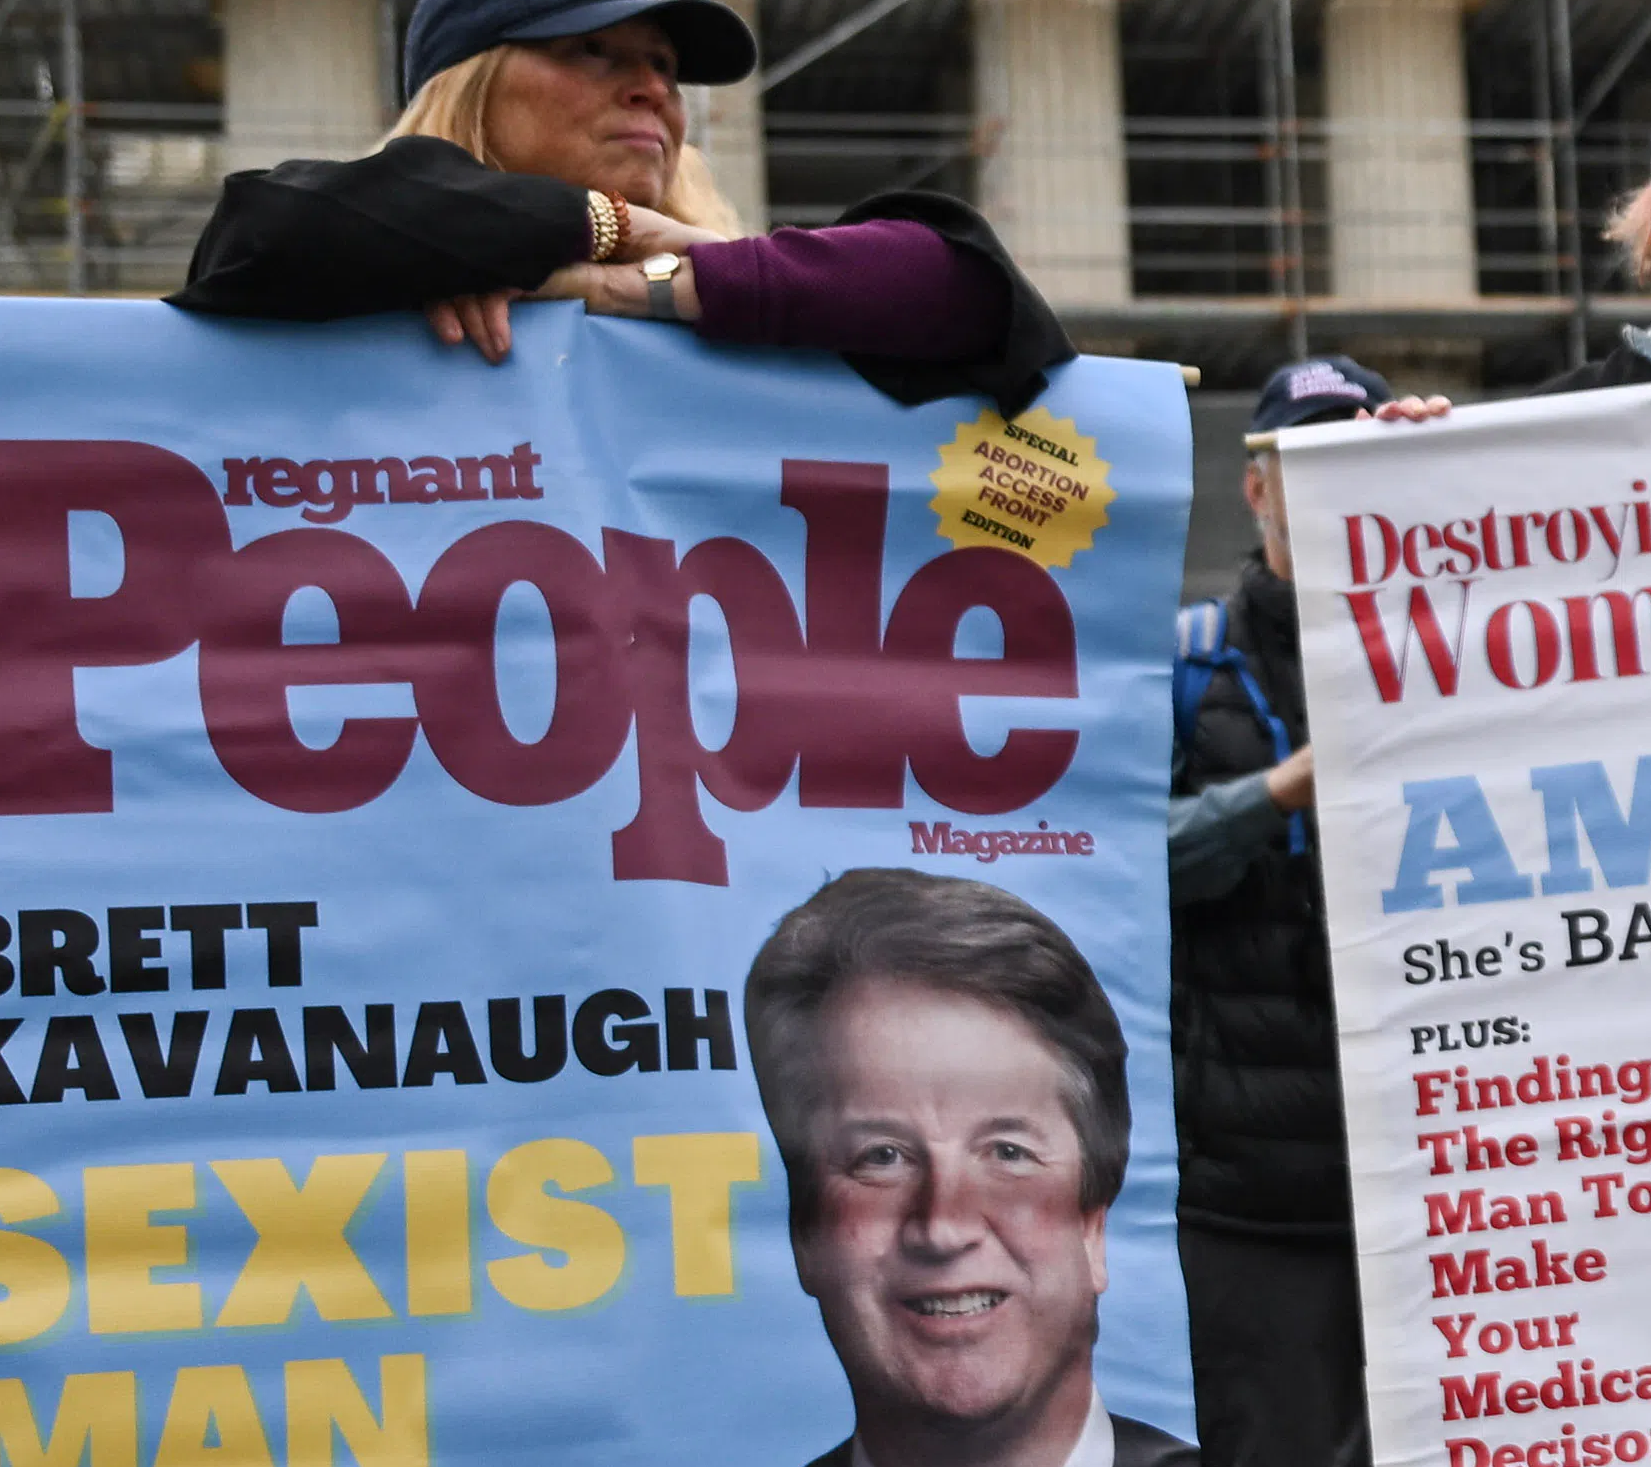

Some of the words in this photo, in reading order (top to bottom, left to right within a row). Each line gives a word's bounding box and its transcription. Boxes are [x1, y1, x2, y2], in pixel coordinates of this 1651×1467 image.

[1004, 423, 1079, 467] SPECIAL
[974, 441, 1090, 501] ABORTION
[979, 466, 1068, 513] ACCESS
[962, 509, 1037, 550] EDITION
[979, 486, 1052, 527] FRONT
[909, 819, 1095, 863] Magazine
[1402, 932, 1545, 986] She's
[1410, 1015, 1530, 1055] PLUS:
[1417, 1125, 1540, 1176] The
[1423, 1185, 1567, 1237] Man
[1429, 1239, 1608, 1299] Make
[1432, 1311, 1580, 1358] Your
